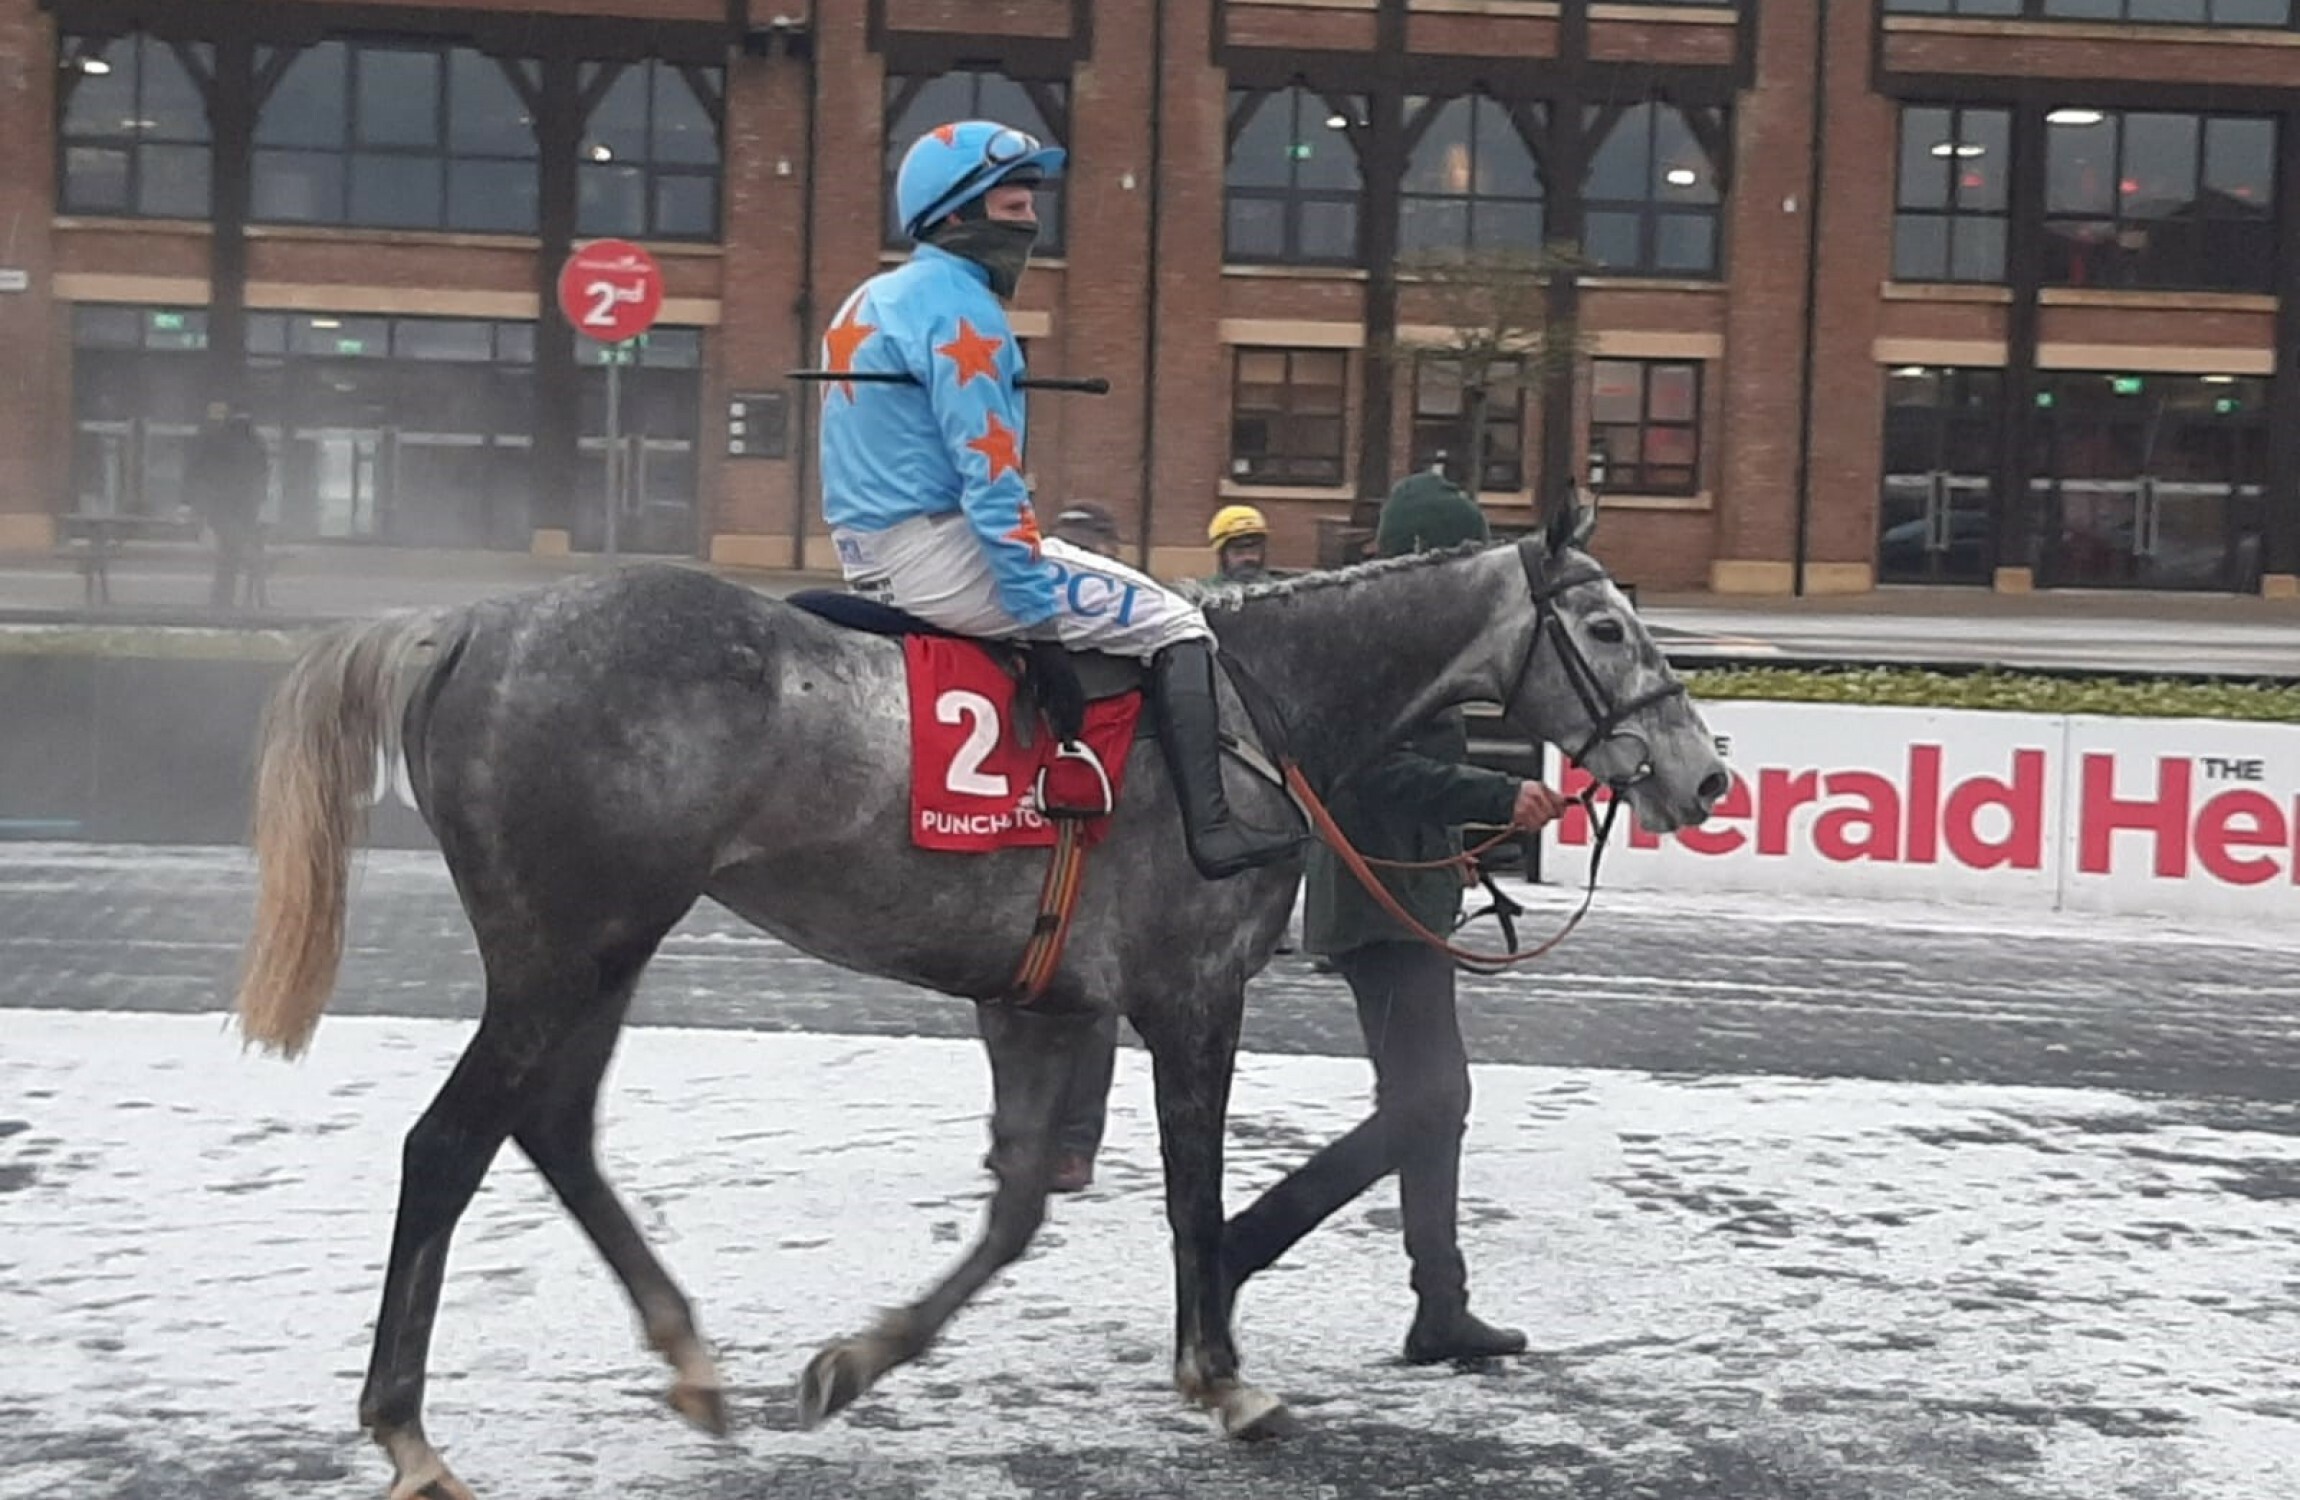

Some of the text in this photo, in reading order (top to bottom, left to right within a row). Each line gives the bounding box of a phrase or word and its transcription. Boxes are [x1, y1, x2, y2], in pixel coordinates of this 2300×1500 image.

[583, 279, 645, 326] 2nd
[936, 689, 1009, 797] 2
[2202, 757, 2265, 781] THE
[2077, 752, 2300, 885] He
